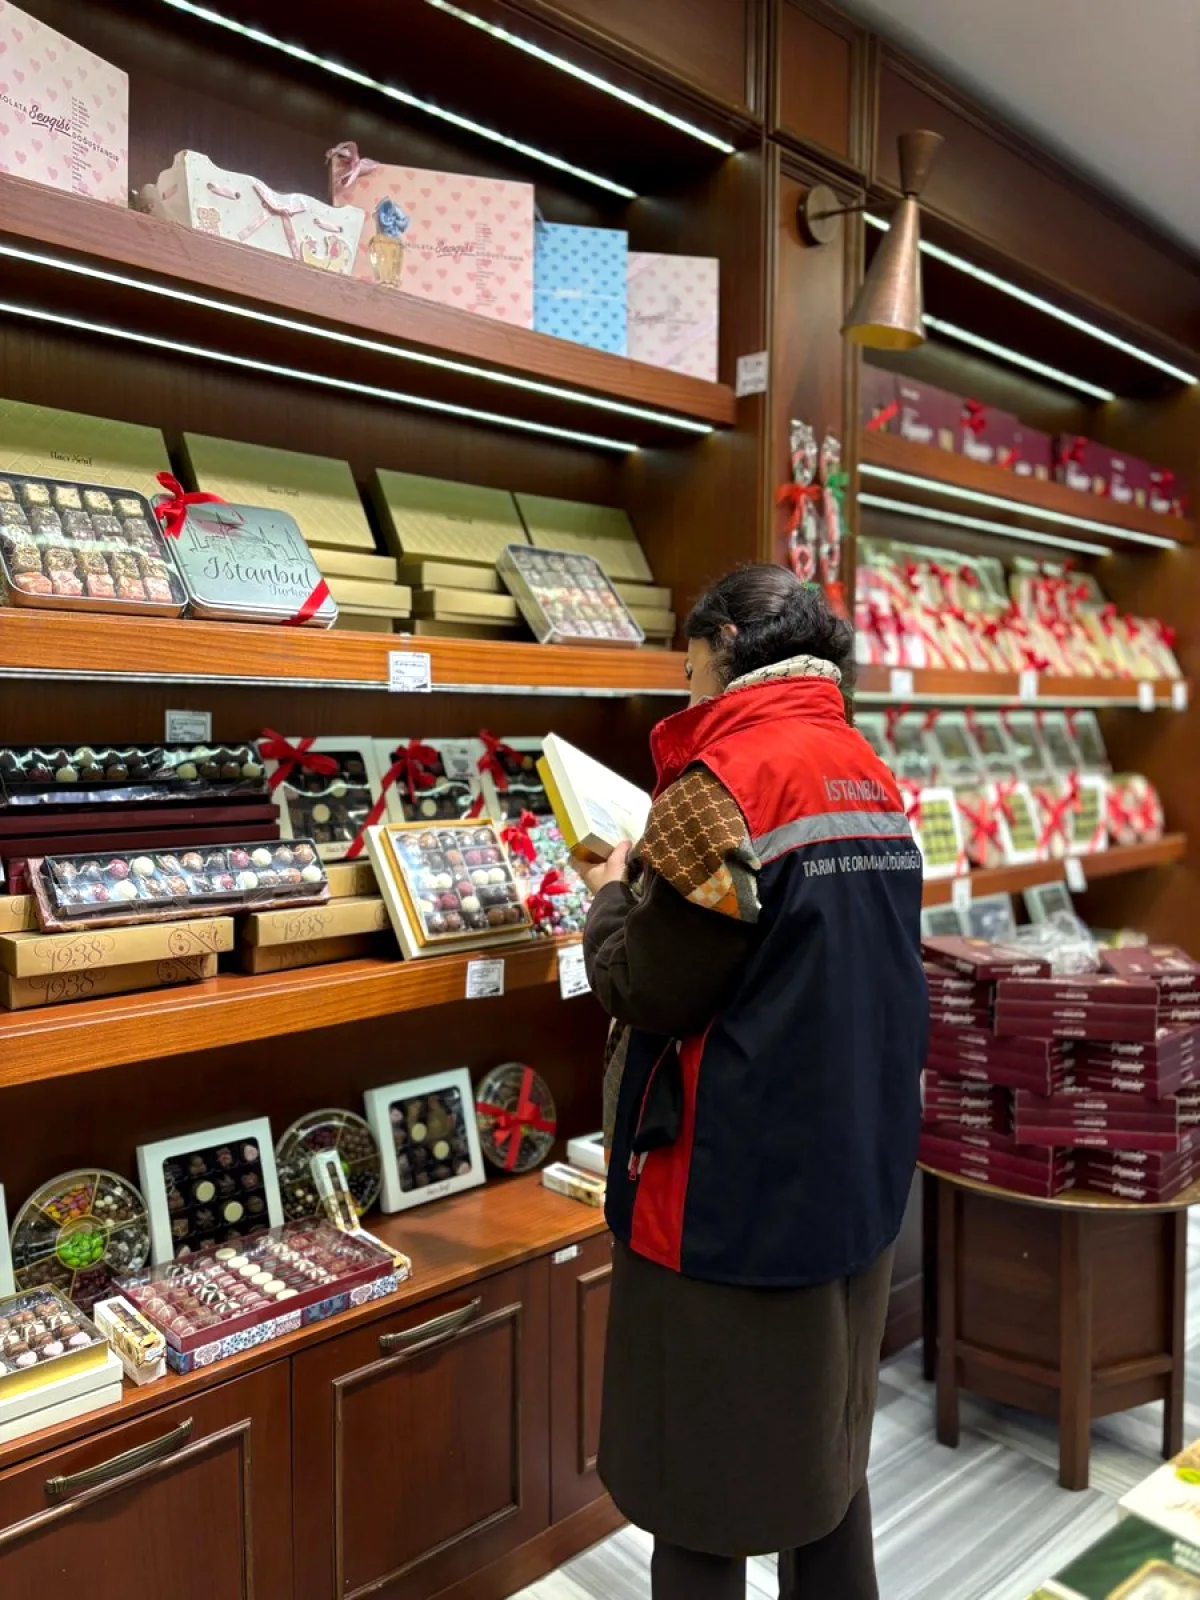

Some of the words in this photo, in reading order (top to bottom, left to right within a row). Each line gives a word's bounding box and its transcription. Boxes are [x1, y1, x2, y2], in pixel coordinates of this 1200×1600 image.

[28, 104, 72, 133] Sevgisi
[203, 556, 313, 590] Istanbul
[823, 775, 888, 801] İSTANBUL
[803, 857, 837, 877] TARIM
[838, 856, 852, 873] VE
[851, 855, 878, 871] ORMA
